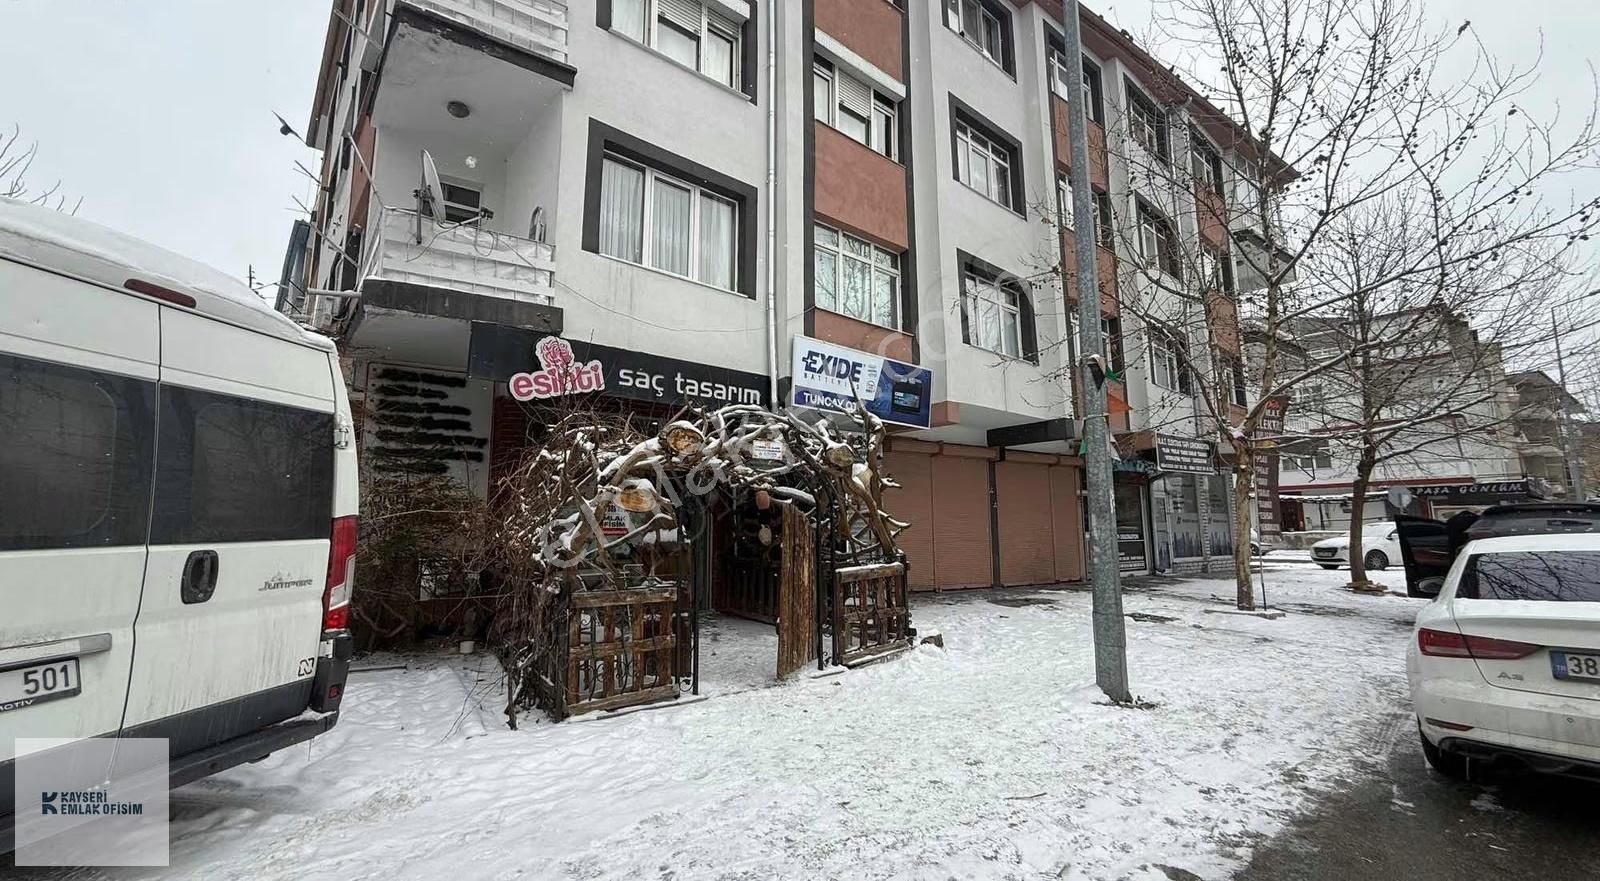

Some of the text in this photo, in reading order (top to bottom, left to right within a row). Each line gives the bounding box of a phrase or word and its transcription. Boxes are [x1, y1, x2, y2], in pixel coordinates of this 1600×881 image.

[802, 350, 864, 382] EXIDE
[619, 368, 761, 405] saç tasarım
[1416, 486, 1450, 496] PAŞA
[24, 664, 70, 695] 501
[1568, 656, 1599, 676] 38
